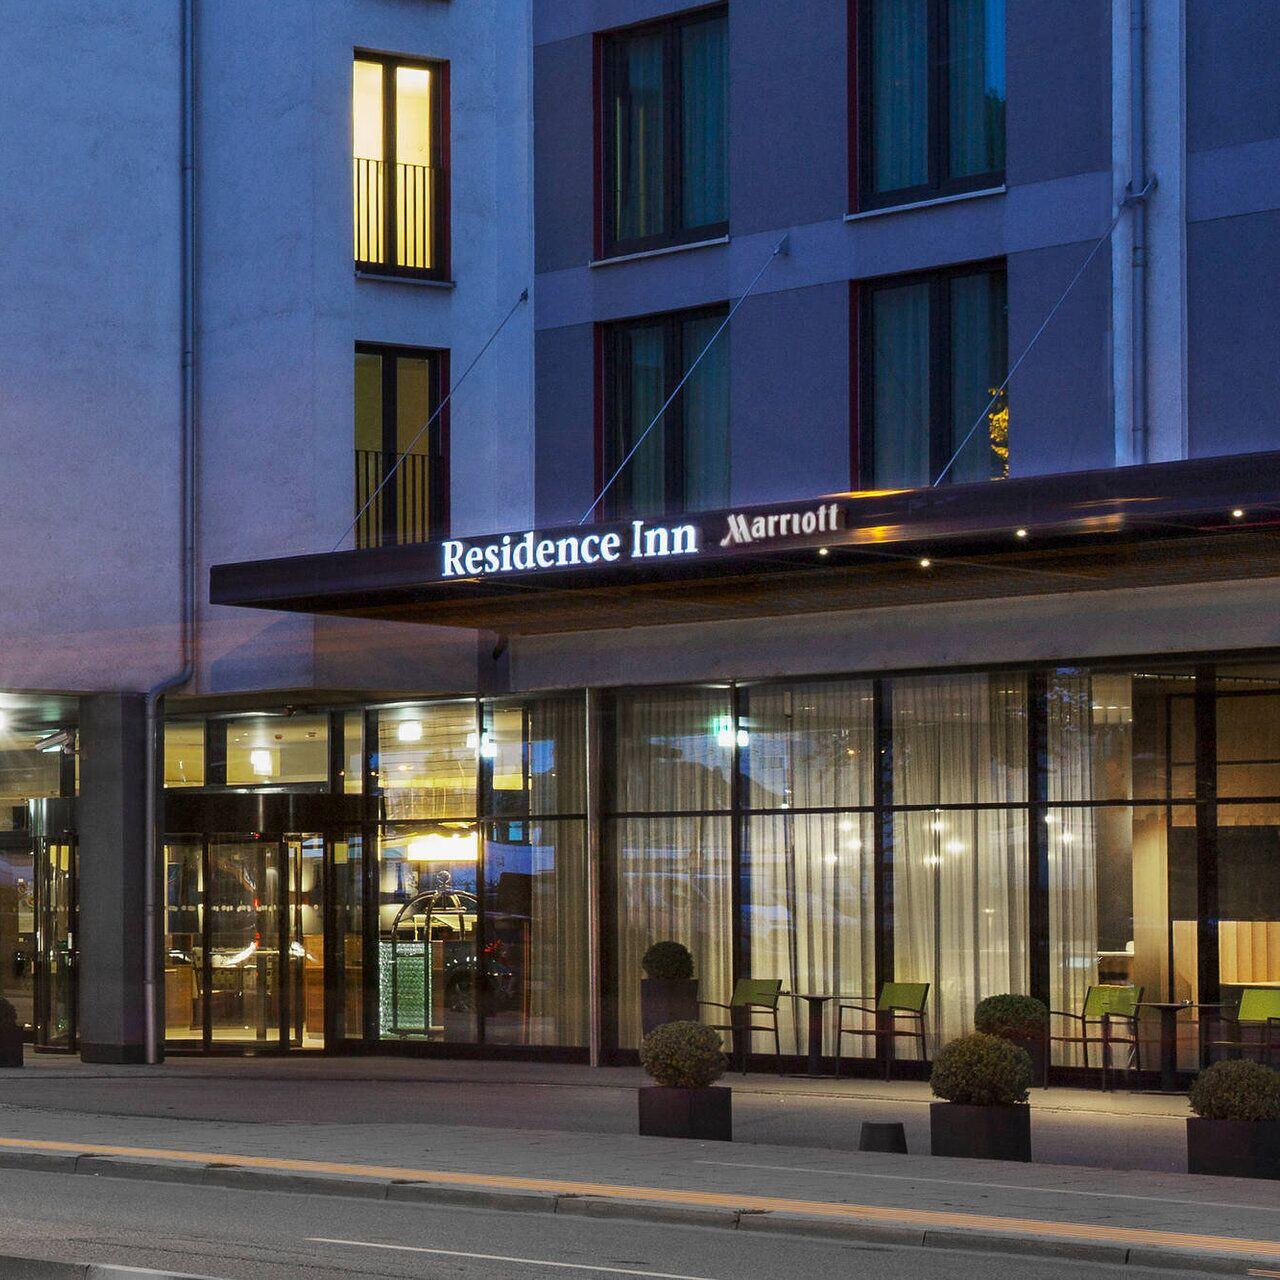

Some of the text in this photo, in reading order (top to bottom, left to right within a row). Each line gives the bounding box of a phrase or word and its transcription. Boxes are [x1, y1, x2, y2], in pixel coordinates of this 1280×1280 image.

[442, 503, 840, 577] Residence Inn Marriott
